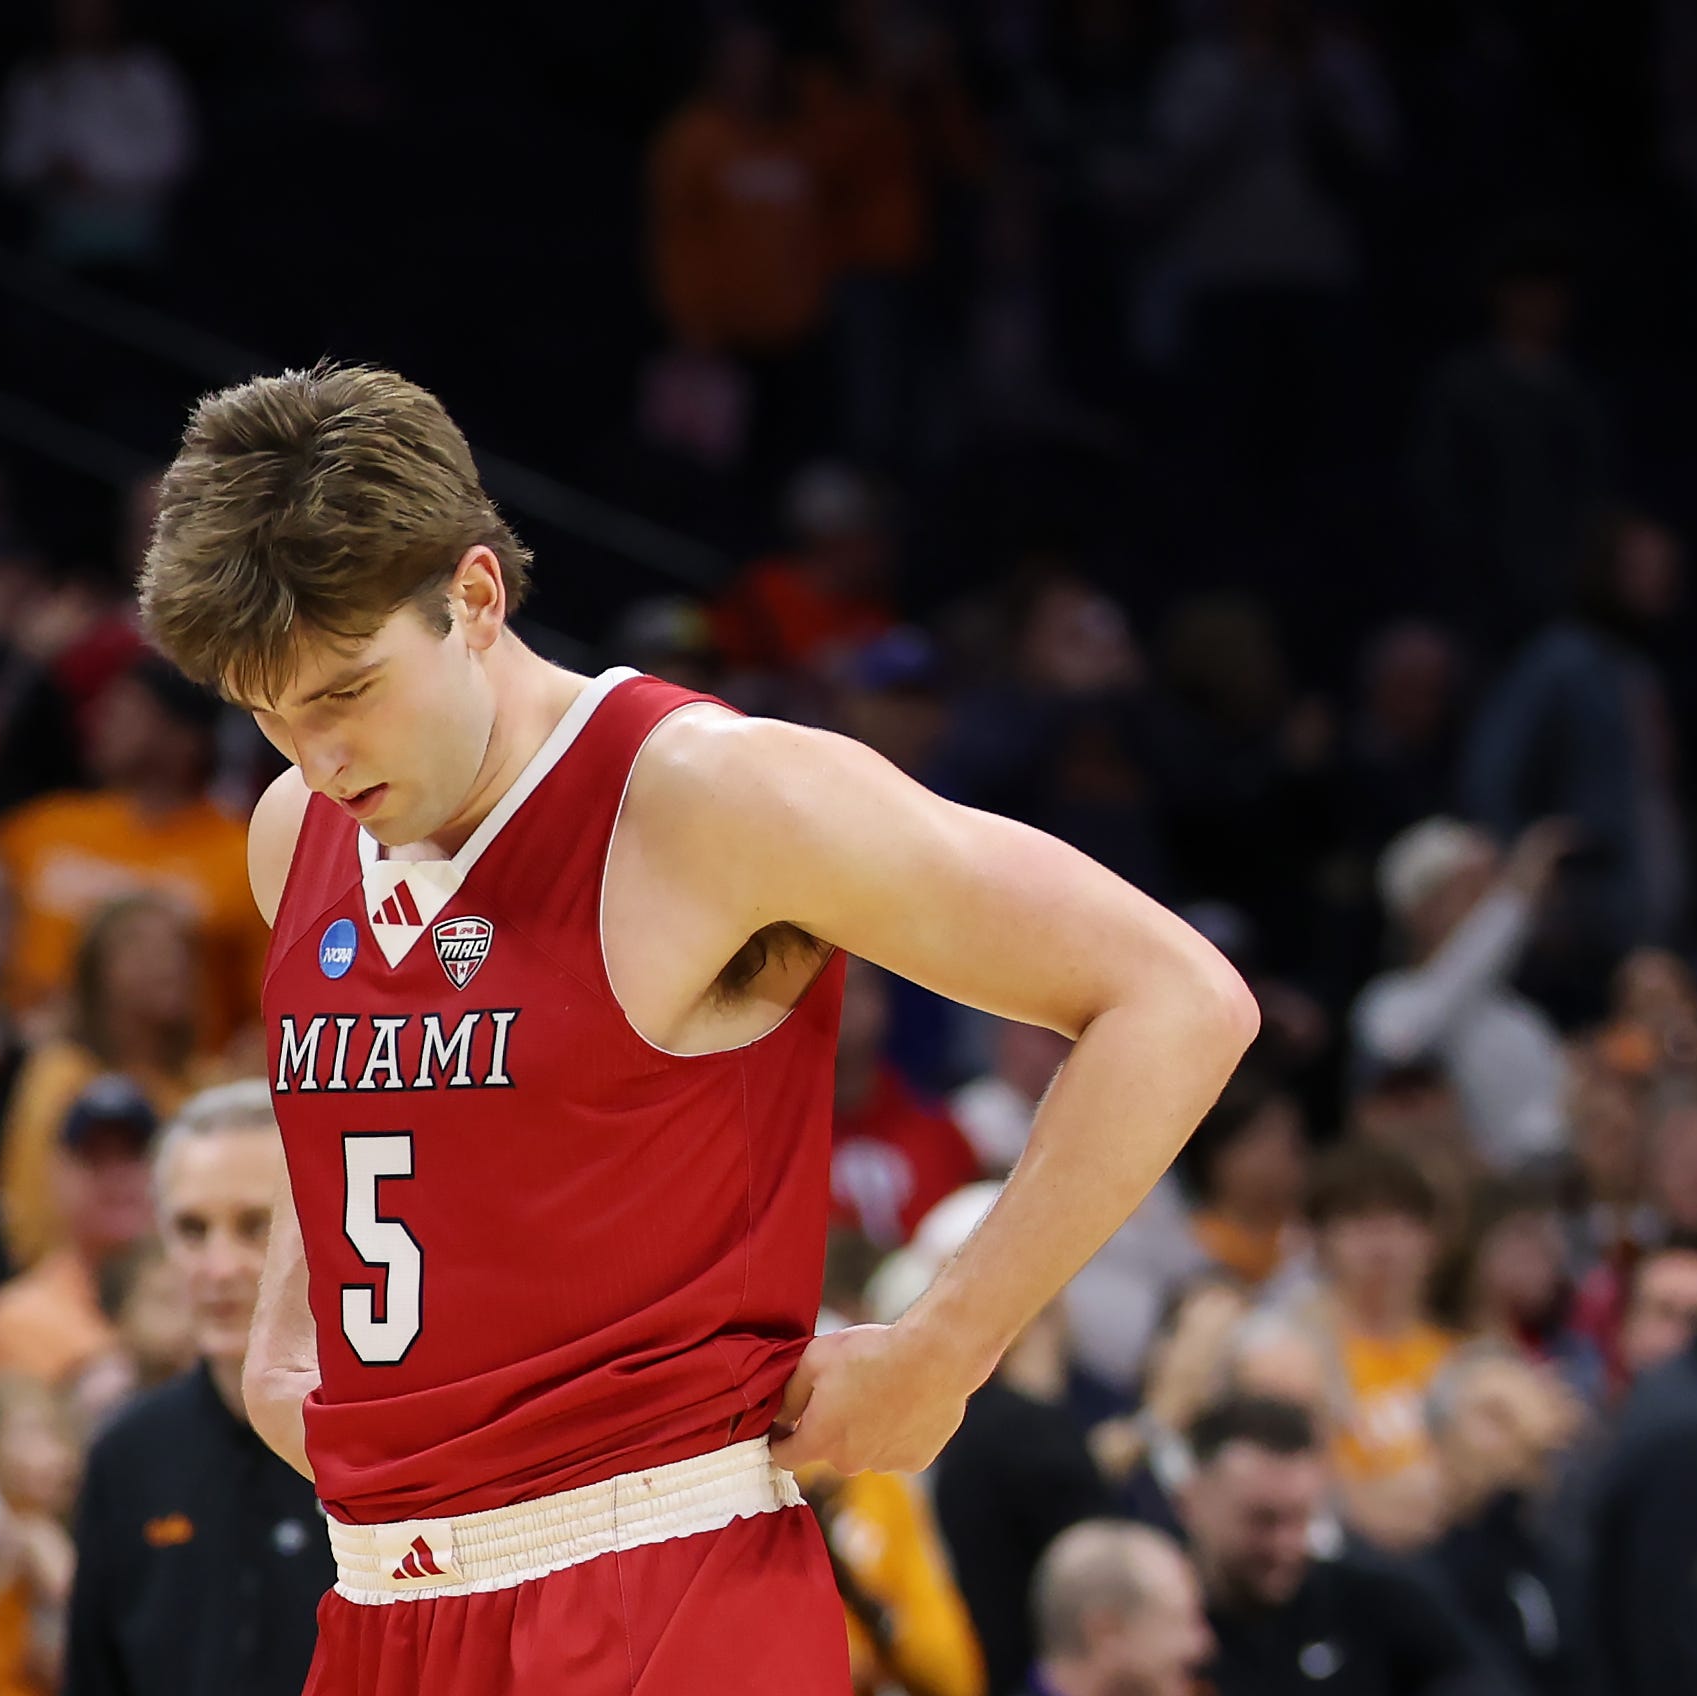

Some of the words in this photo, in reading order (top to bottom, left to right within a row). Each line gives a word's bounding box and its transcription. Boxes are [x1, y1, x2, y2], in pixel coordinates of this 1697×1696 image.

[322, 947, 353, 964] NCAA
[438, 939, 487, 960] MAC
[275, 1009, 522, 1094] MIAMI
[341, 1131, 424, 1367] 5
